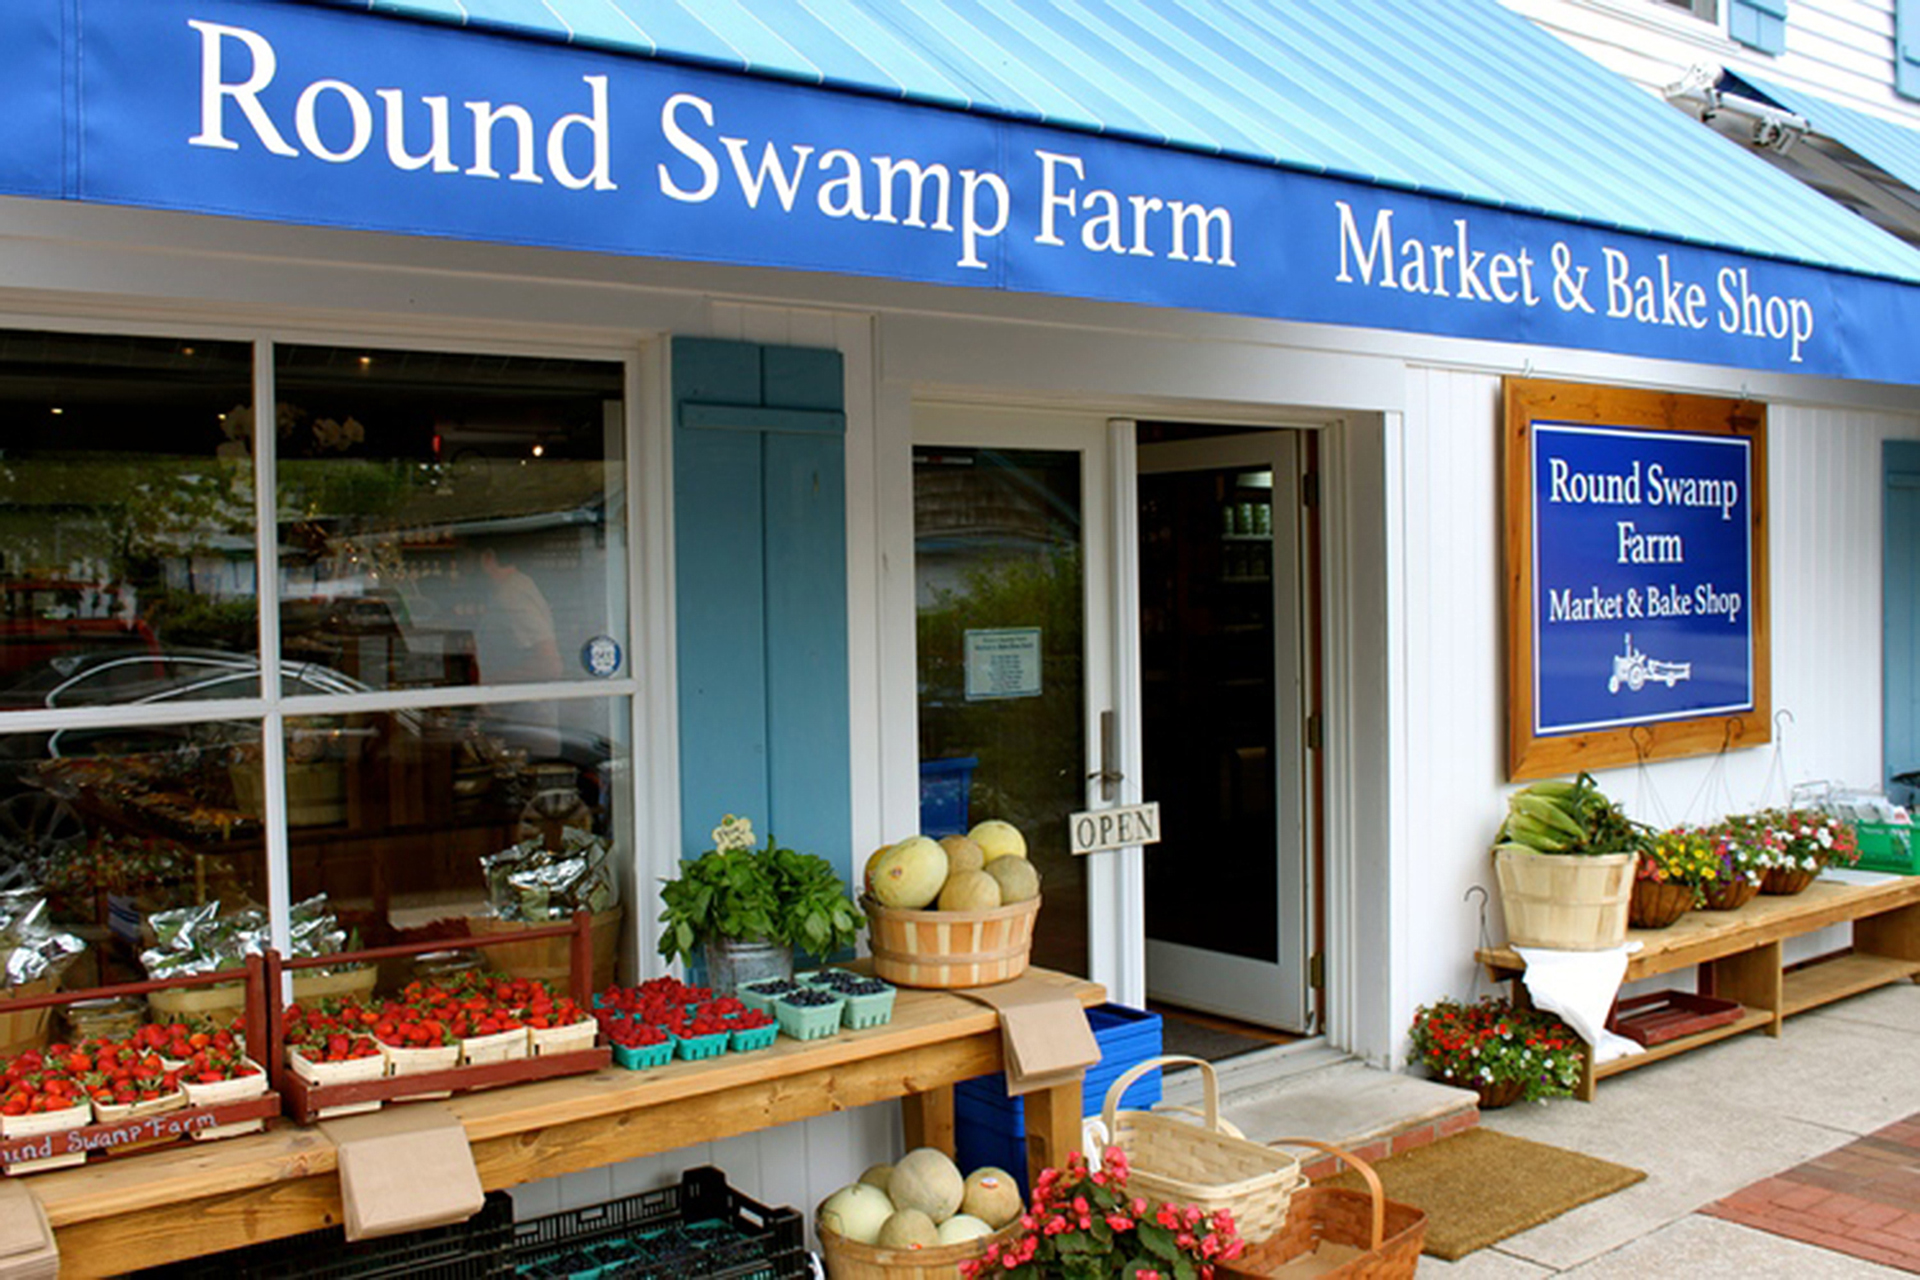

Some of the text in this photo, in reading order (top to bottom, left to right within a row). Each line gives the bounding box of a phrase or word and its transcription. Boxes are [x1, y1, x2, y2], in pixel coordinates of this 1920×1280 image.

[187, 19, 1238, 270] Round Swamp Farm
[1334, 200, 1814, 363] Market & Bake Shop
[1549, 458, 1738, 520] Round Swamp
[1617, 521, 1684, 564] Farm
[1549, 583, 1742, 623] Market & Bake Shop
[1076, 809, 1154, 849] OPEN
[144, 1113, 218, 1137] Farm
